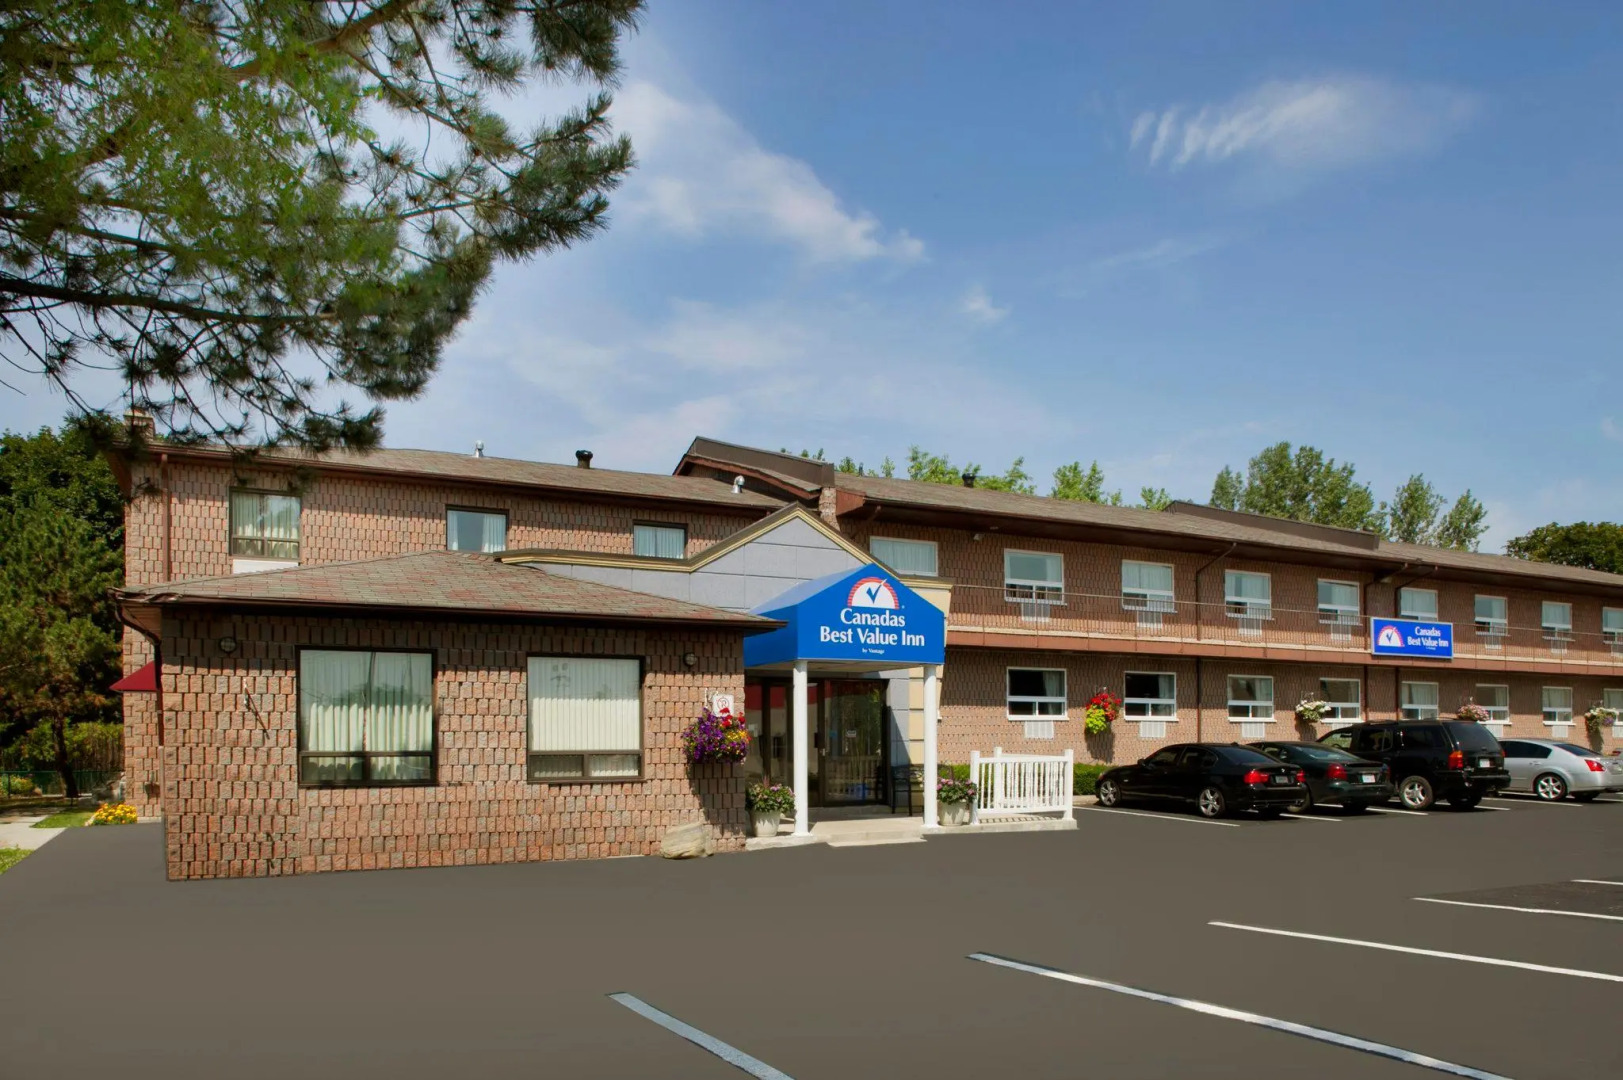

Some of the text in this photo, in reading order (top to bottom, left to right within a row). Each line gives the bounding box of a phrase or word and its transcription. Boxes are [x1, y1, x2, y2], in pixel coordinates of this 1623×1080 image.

[840, 608, 906, 627] Canadas
[820, 626, 925, 647] Best Value Inn
[1415, 626, 1440, 636] Canadas
[1407, 636, 1448, 647] Best Value Inn
